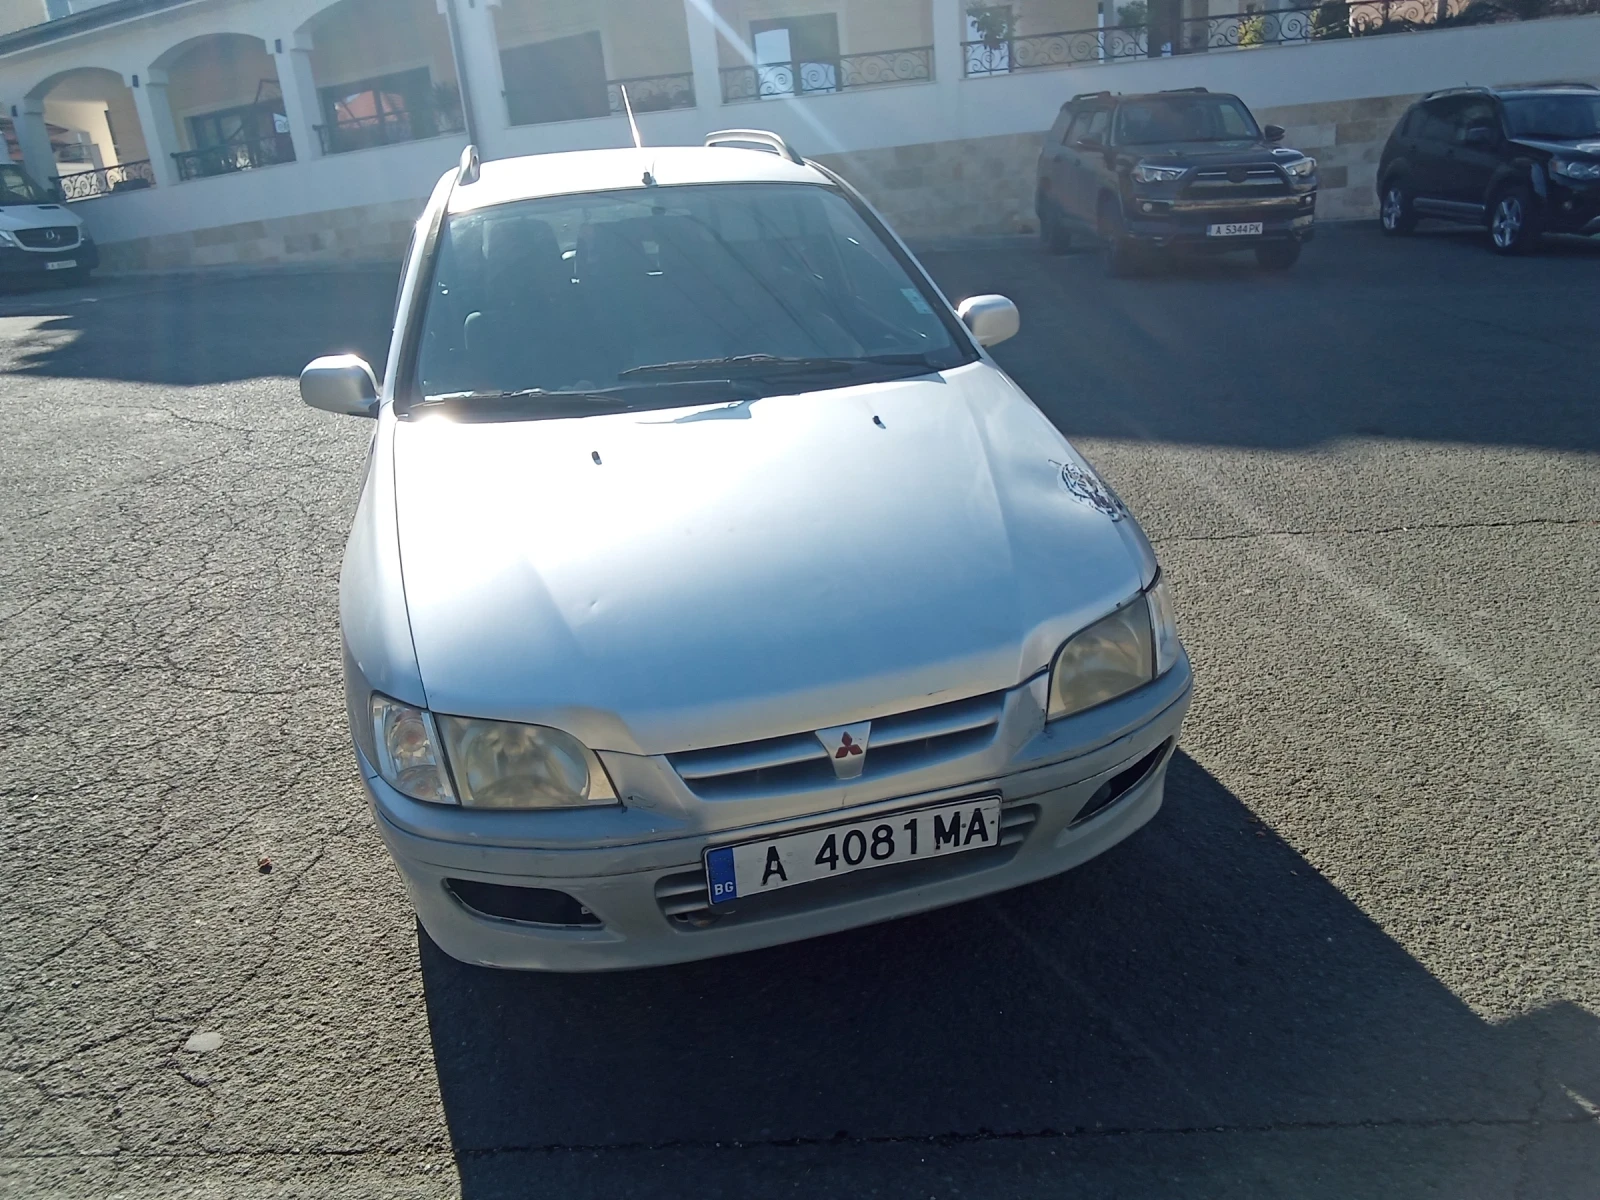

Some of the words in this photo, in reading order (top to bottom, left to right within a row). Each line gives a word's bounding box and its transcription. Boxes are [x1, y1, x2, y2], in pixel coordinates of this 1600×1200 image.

[1215, 226, 1222, 235] A
[1225, 224, 1248, 235] 5344
[1249, 223, 1261, 233] PK
[760, 845, 788, 886] A
[814, 818, 918, 871] 4081
[933, 807, 989, 850] MA
[714, 880, 735, 896] BG
